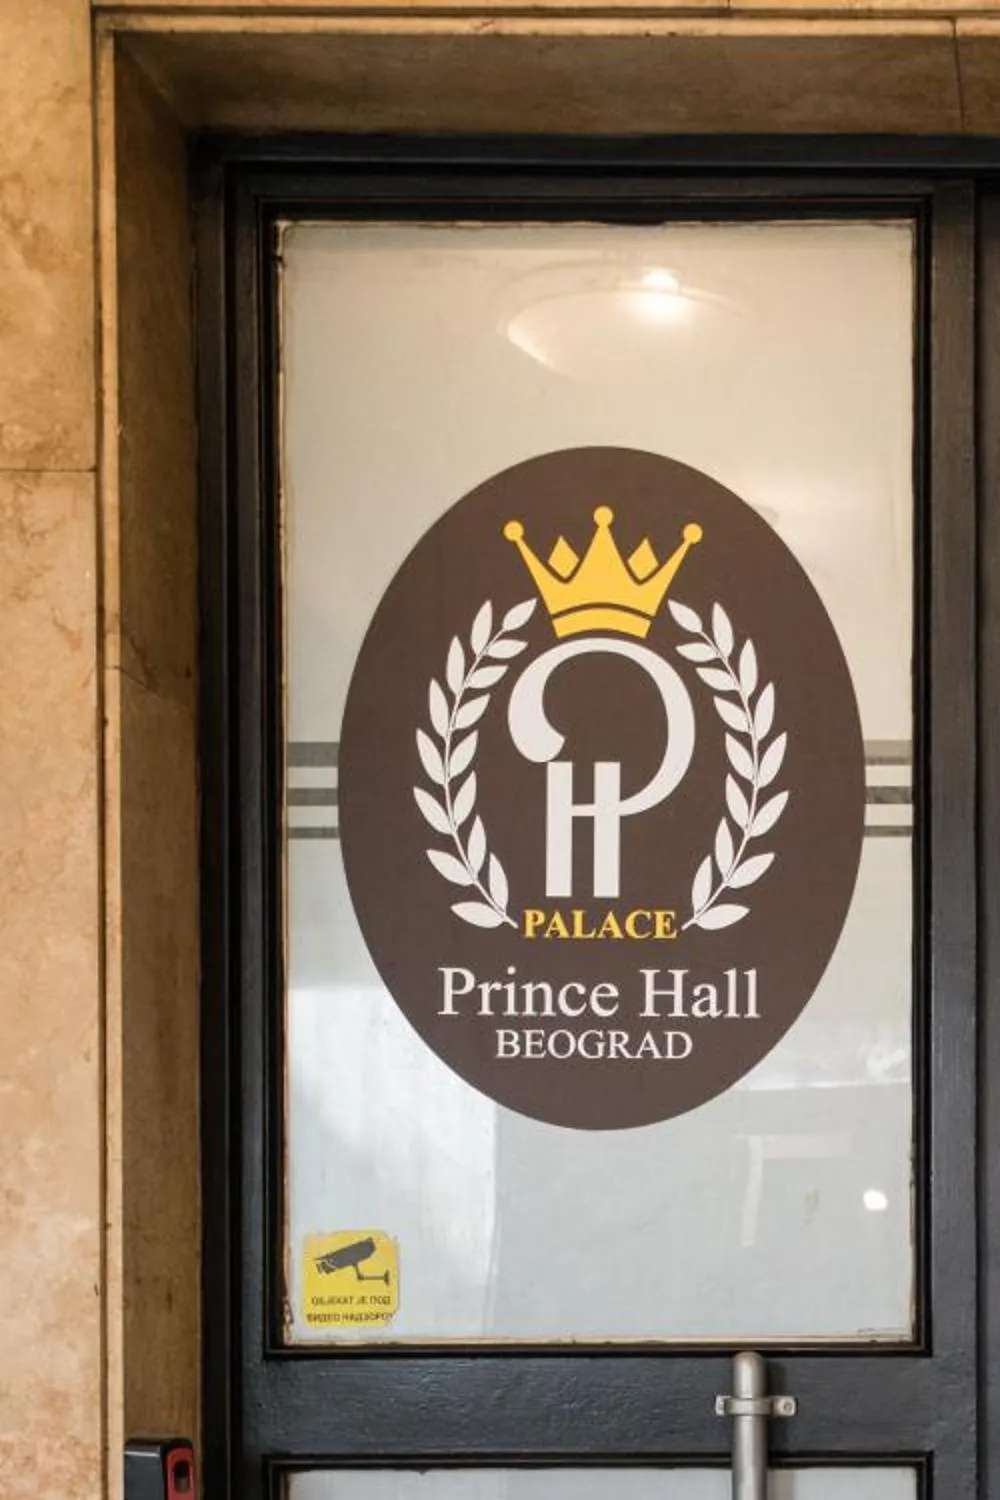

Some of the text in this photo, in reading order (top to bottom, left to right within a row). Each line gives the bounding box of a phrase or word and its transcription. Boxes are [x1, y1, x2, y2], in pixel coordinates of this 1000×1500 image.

[523, 908, 679, 940] PALACE
[437, 965, 762, 1018] Prince Hall
[495, 1028, 693, 1060] BEOGRAD
